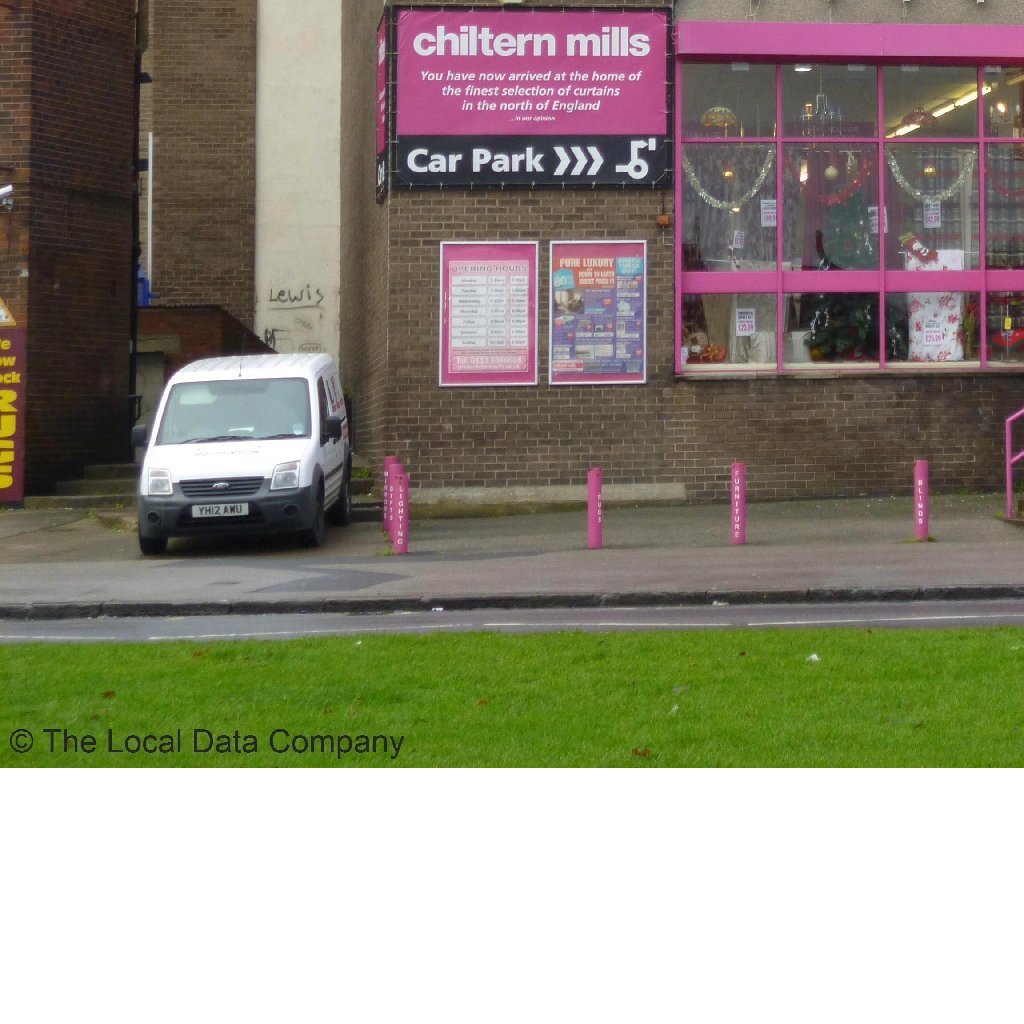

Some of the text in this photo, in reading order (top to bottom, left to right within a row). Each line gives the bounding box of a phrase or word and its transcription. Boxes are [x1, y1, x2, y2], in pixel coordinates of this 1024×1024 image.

[413, 25, 556, 57] chiltern
[566, 26, 650, 57] mills
[421, 70, 642, 82] You have now arrived at the home of
[442, 85, 620, 97] the finest selection of curtains
[462, 100, 600, 113] in the north of England
[407, 148, 462, 173] Car
[472, 147, 544, 173] Park
[560, 257, 581, 268] PURE
[583, 257, 614, 268] LUXURY
[269, 284, 324, 305] Lewis
[198, 504, 243, 516] YH12 AWU
